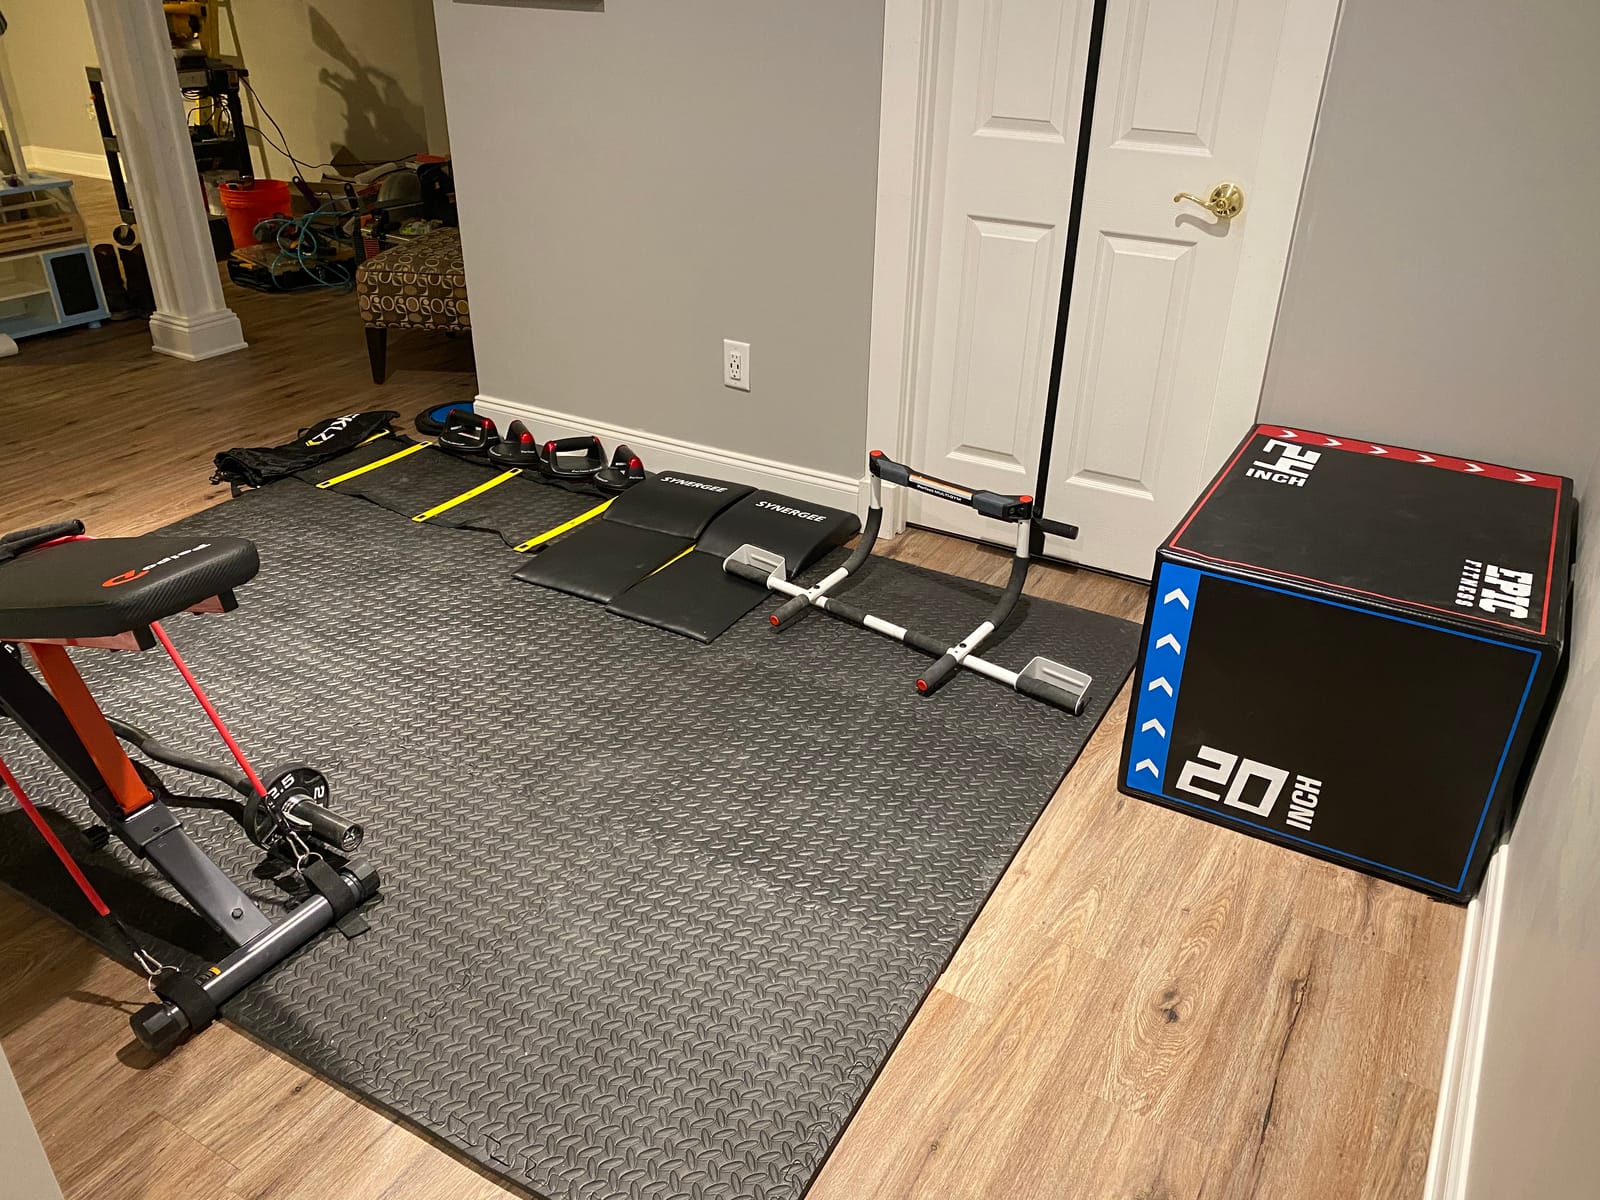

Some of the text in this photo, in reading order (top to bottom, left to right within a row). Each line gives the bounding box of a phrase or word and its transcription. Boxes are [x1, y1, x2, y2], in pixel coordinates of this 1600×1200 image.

[1245, 467, 1307, 488] INCH
[1253, 438, 1322, 479] 24
[660, 476, 728, 494] SYNERGEE
[755, 500, 827, 523] SYNERGEE
[1455, 559, 1482, 608] FITNESS
[1479, 564, 1533, 619] EPIC
[267, 773, 295, 800] 2.5
[1175, 744, 1290, 818] 20
[1286, 774, 1323, 832] INCH
